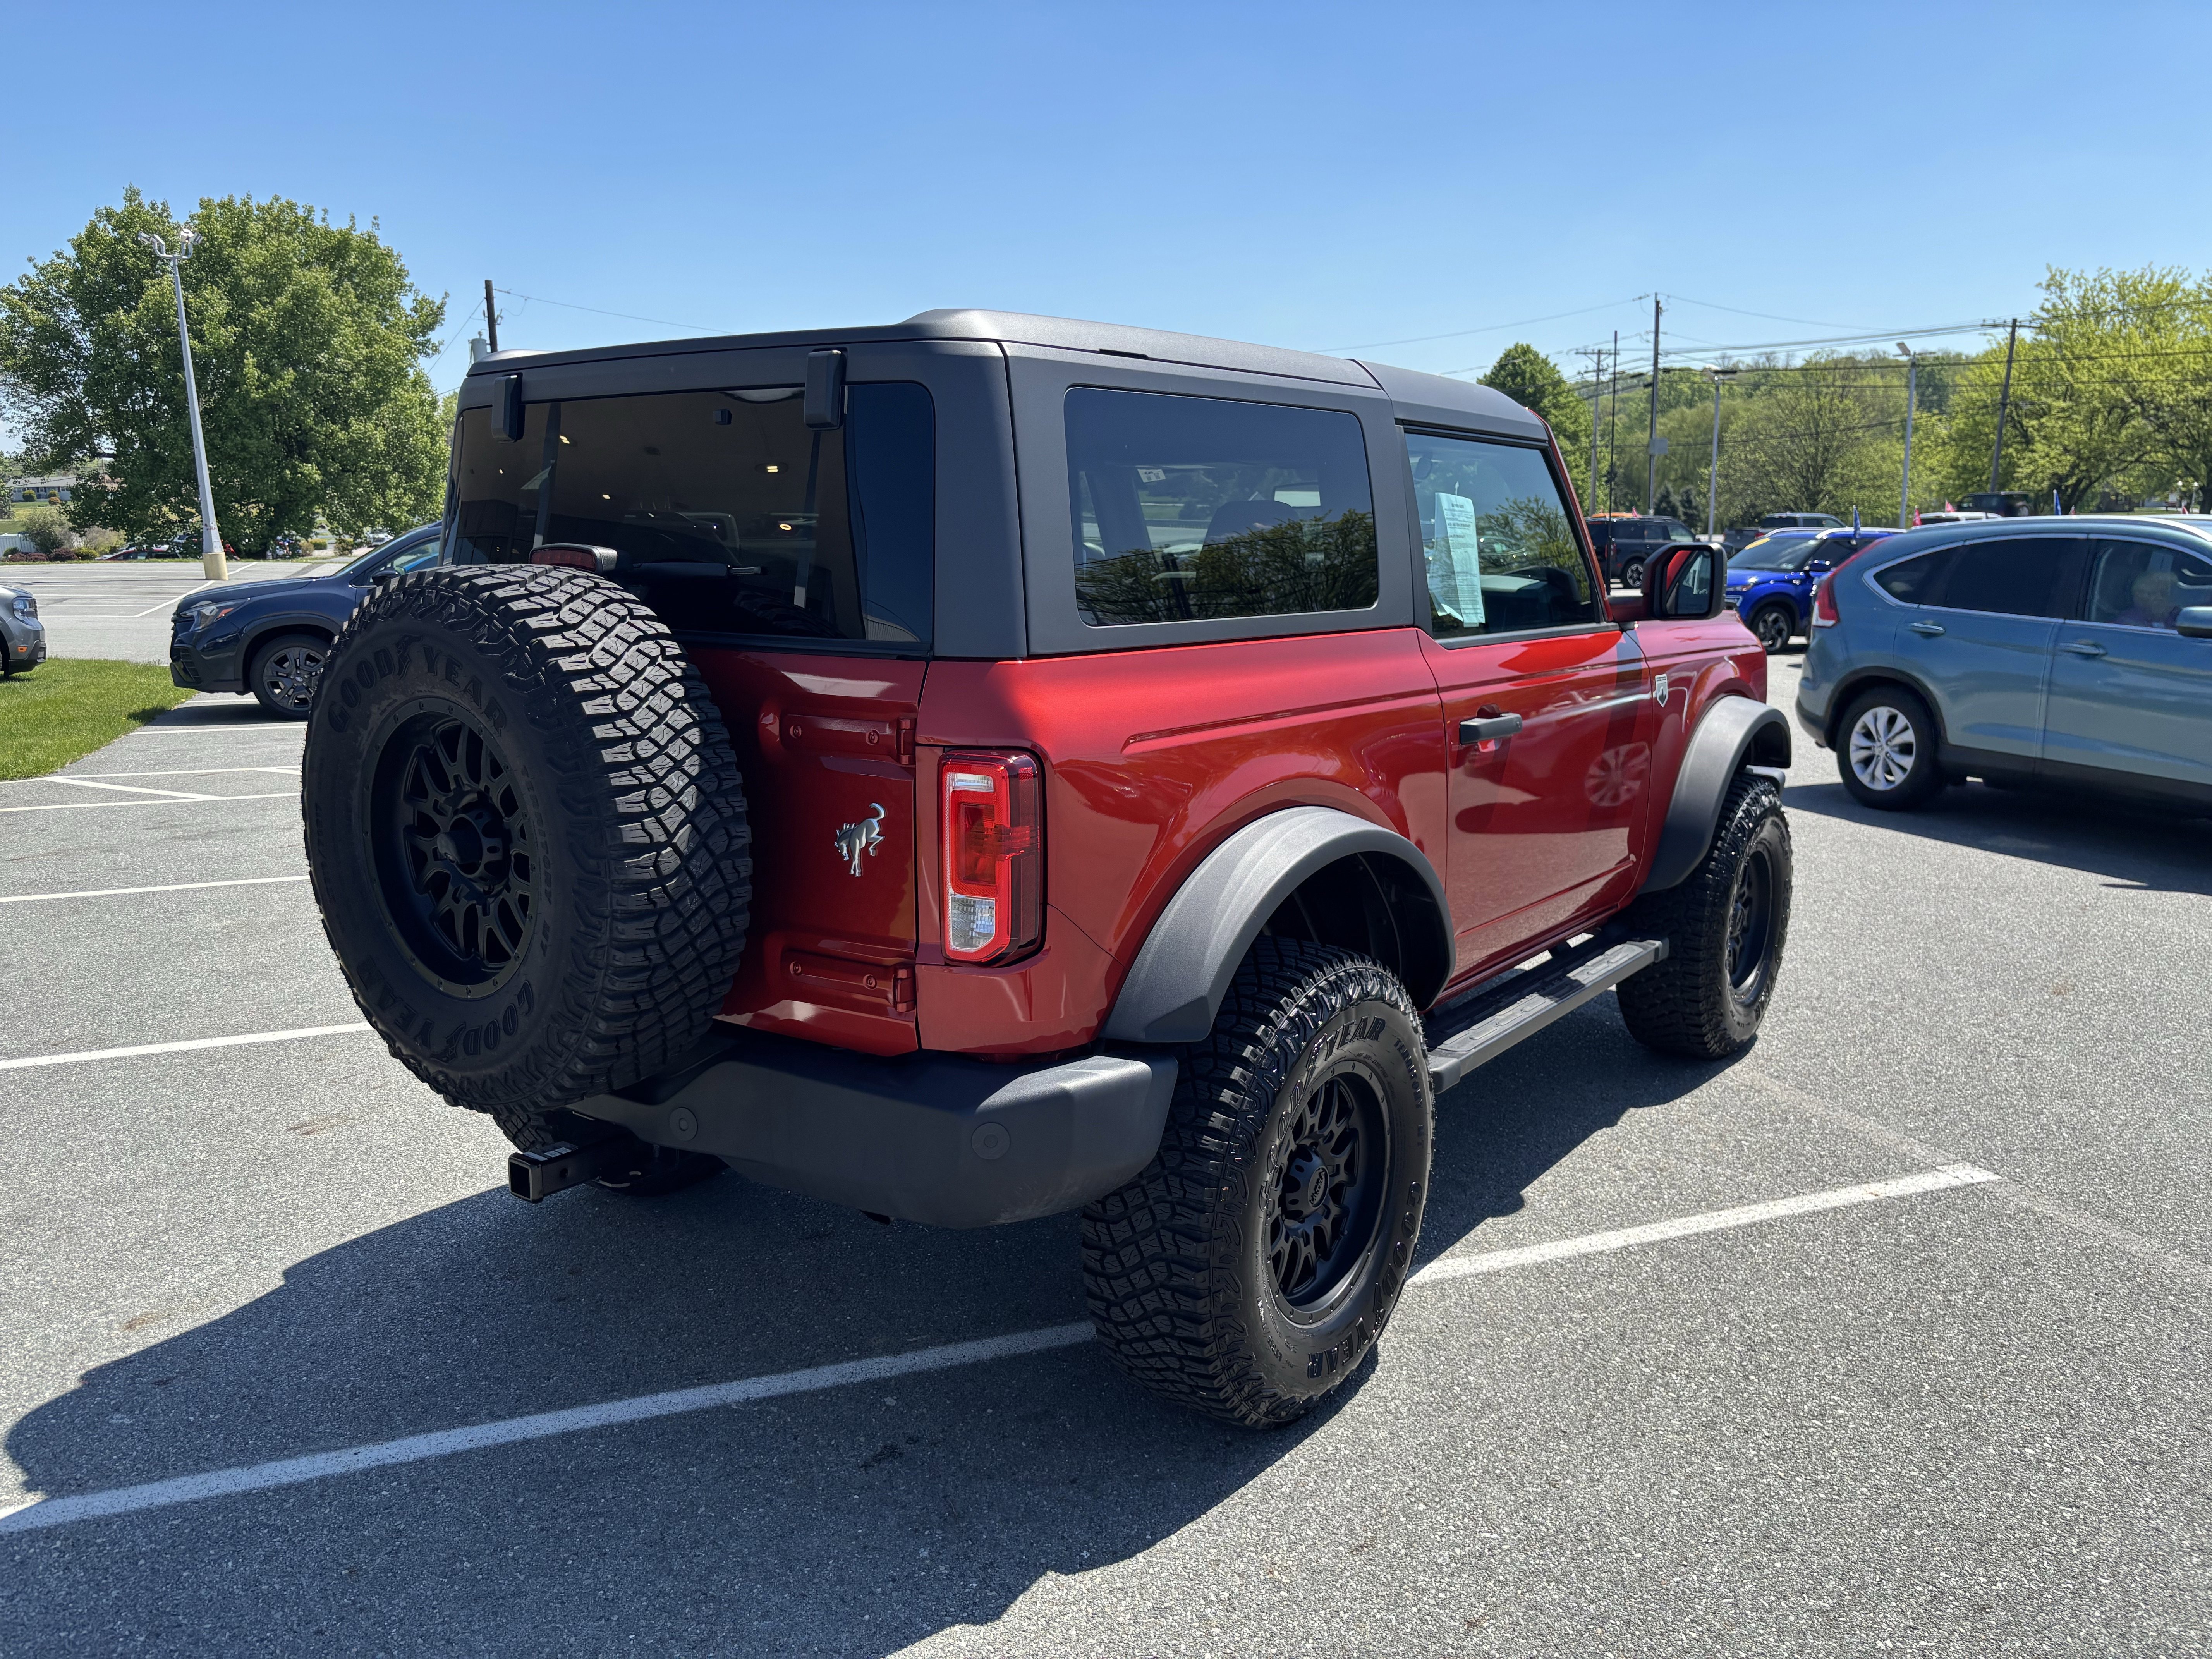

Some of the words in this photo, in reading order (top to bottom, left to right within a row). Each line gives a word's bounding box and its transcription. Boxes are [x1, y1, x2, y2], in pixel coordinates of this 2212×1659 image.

[328, 635, 506, 737] GOODYEAR
[522, 765, 551, 905] TERRITORY
[356, 956, 533, 1065] GOODYEAR
[1393, 1038, 1423, 1109] TERRITORY
[1307, 1181, 1422, 1379] GOODYEAR
